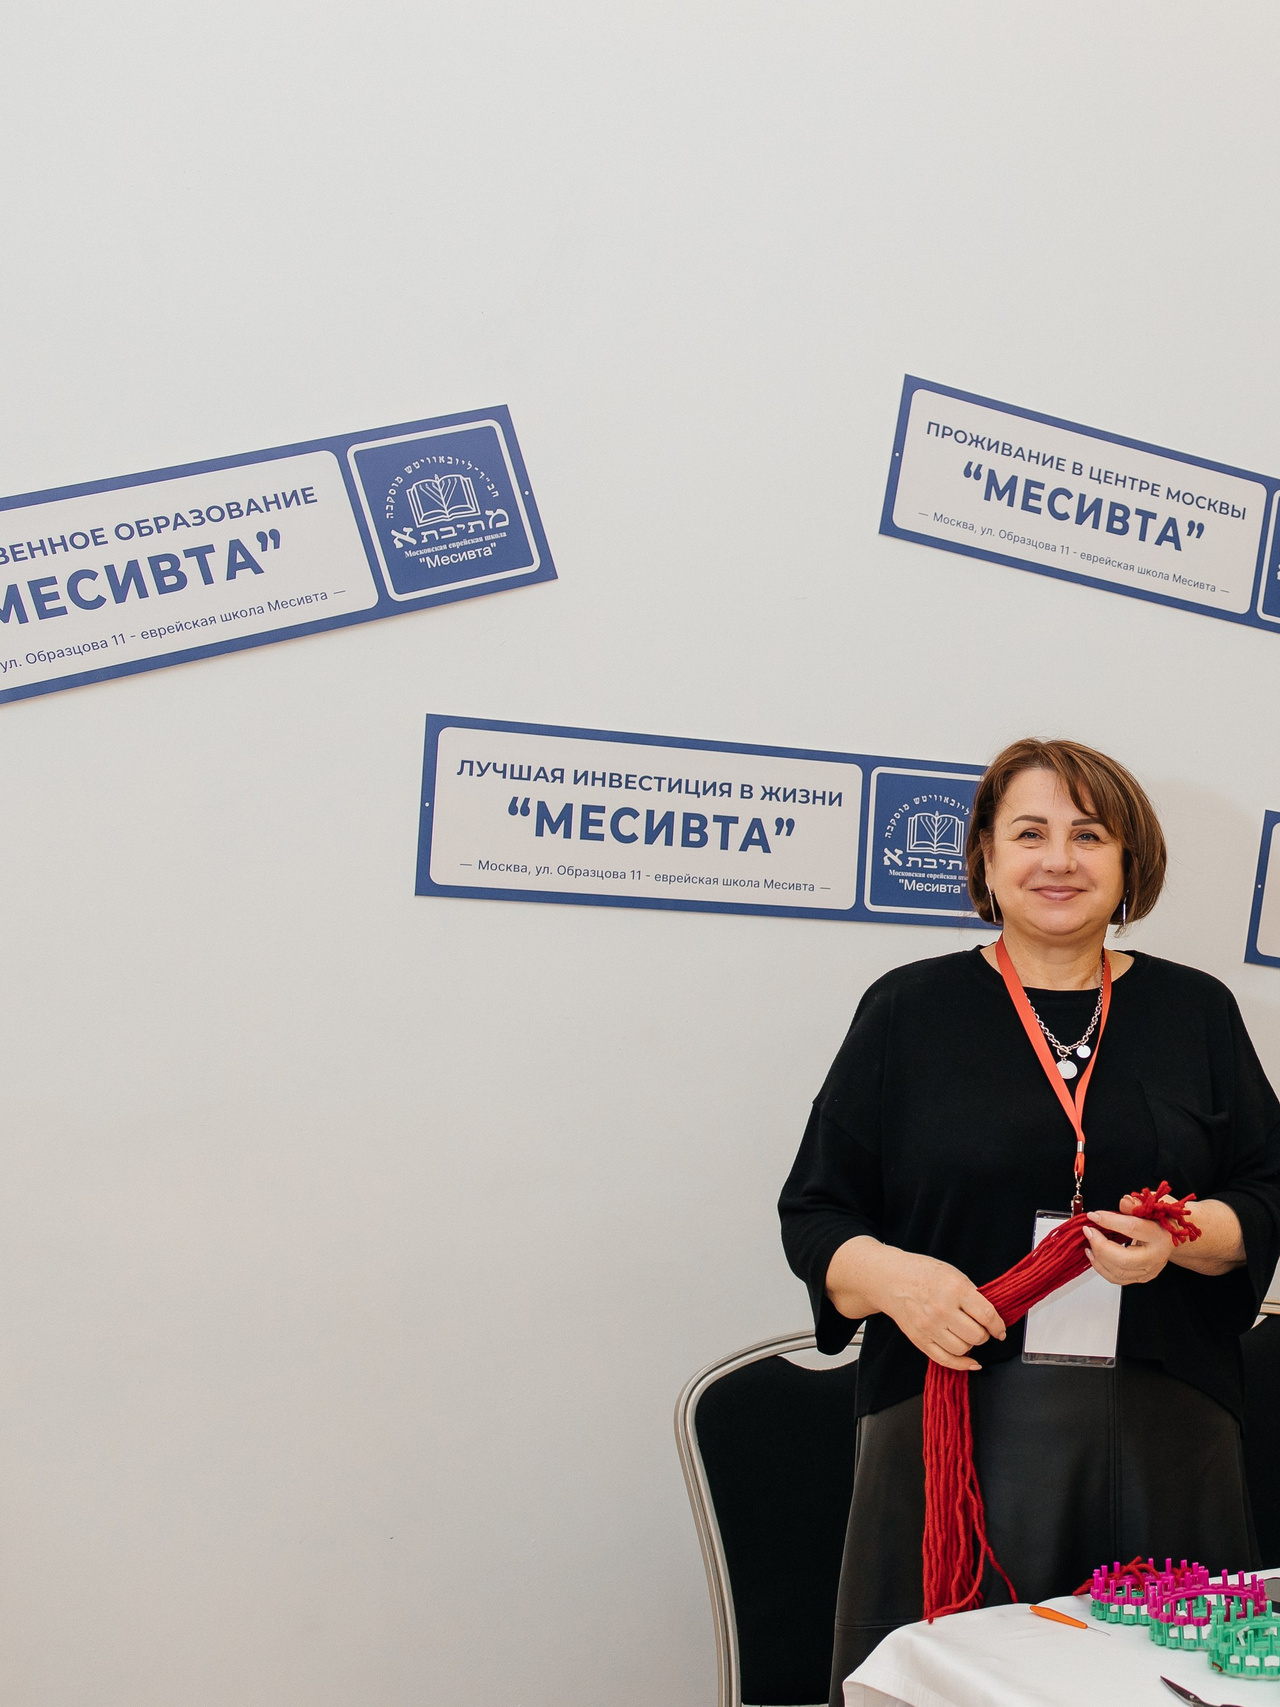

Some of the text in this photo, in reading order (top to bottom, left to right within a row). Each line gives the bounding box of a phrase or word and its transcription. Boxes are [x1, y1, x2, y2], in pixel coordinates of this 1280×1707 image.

[926, 421, 1246, 520] ПРОЖИВАНИЕ В ЦЕНТРЕ МОСКВЫ
[385, 476, 403, 519] מוסקבה
[963, 461, 1205, 551] “МЕСИВТА”
[0, 486, 318, 565] ВЕННОЕ ОБРАЗОВАНИЕ
[390, 508, 509, 548] מתיבתא
[404, 531, 507, 557] Московская еврейская школа
[419, 542, 496, 568] "Месивта"
[933, 512, 1216, 592] Москва, ул. Образцова 11 еврейская школа Месивта
[0, 591, 328, 673] ул. Образцова 11 еврейская школа Месивта
[456, 759, 842, 807] ЛУЧШАЯ ИНВЕСТИЦИЯ В ЖИЗНИ
[507, 796, 795, 853] “МЕСИВТА”
[884, 803, 909, 838] מוסקבה
[478, 859, 814, 891] Москва, ул. Образцова 11 еврейская школа Месивта
[883, 847, 968, 871] תיבתא
[889, 868, 925, 878] Московская
[926, 872, 957, 880] еврейская
[898, 878, 966, 894] "Месивта"
